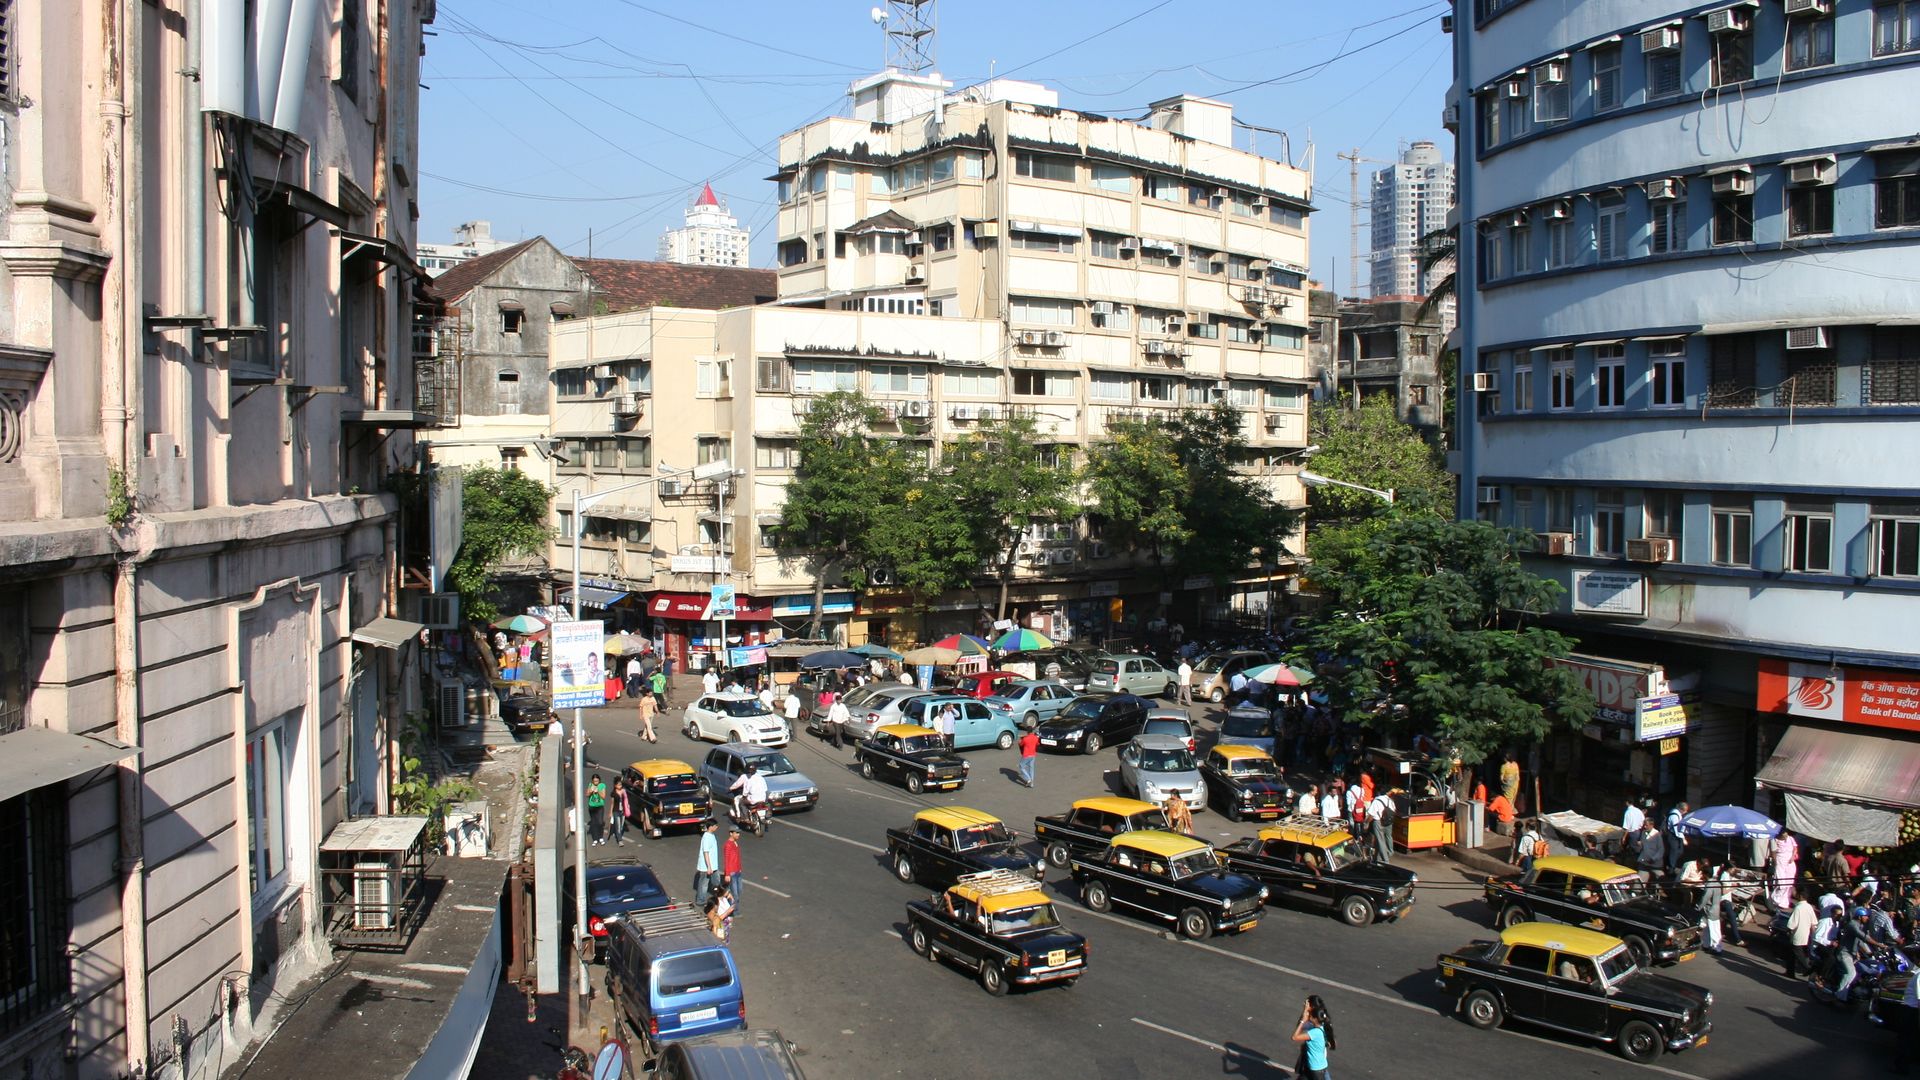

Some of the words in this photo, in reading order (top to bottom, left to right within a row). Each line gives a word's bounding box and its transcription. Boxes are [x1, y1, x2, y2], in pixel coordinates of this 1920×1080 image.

[576, 691, 593, 699] Road
[555, 698, 604, 709] 32152824
[1861, 706, 1882, 716] Bank
[1883, 709, 1891, 717] of
[1892, 709, 1920, 720] Baroda
[1643, 720, 1663, 729] Railway
